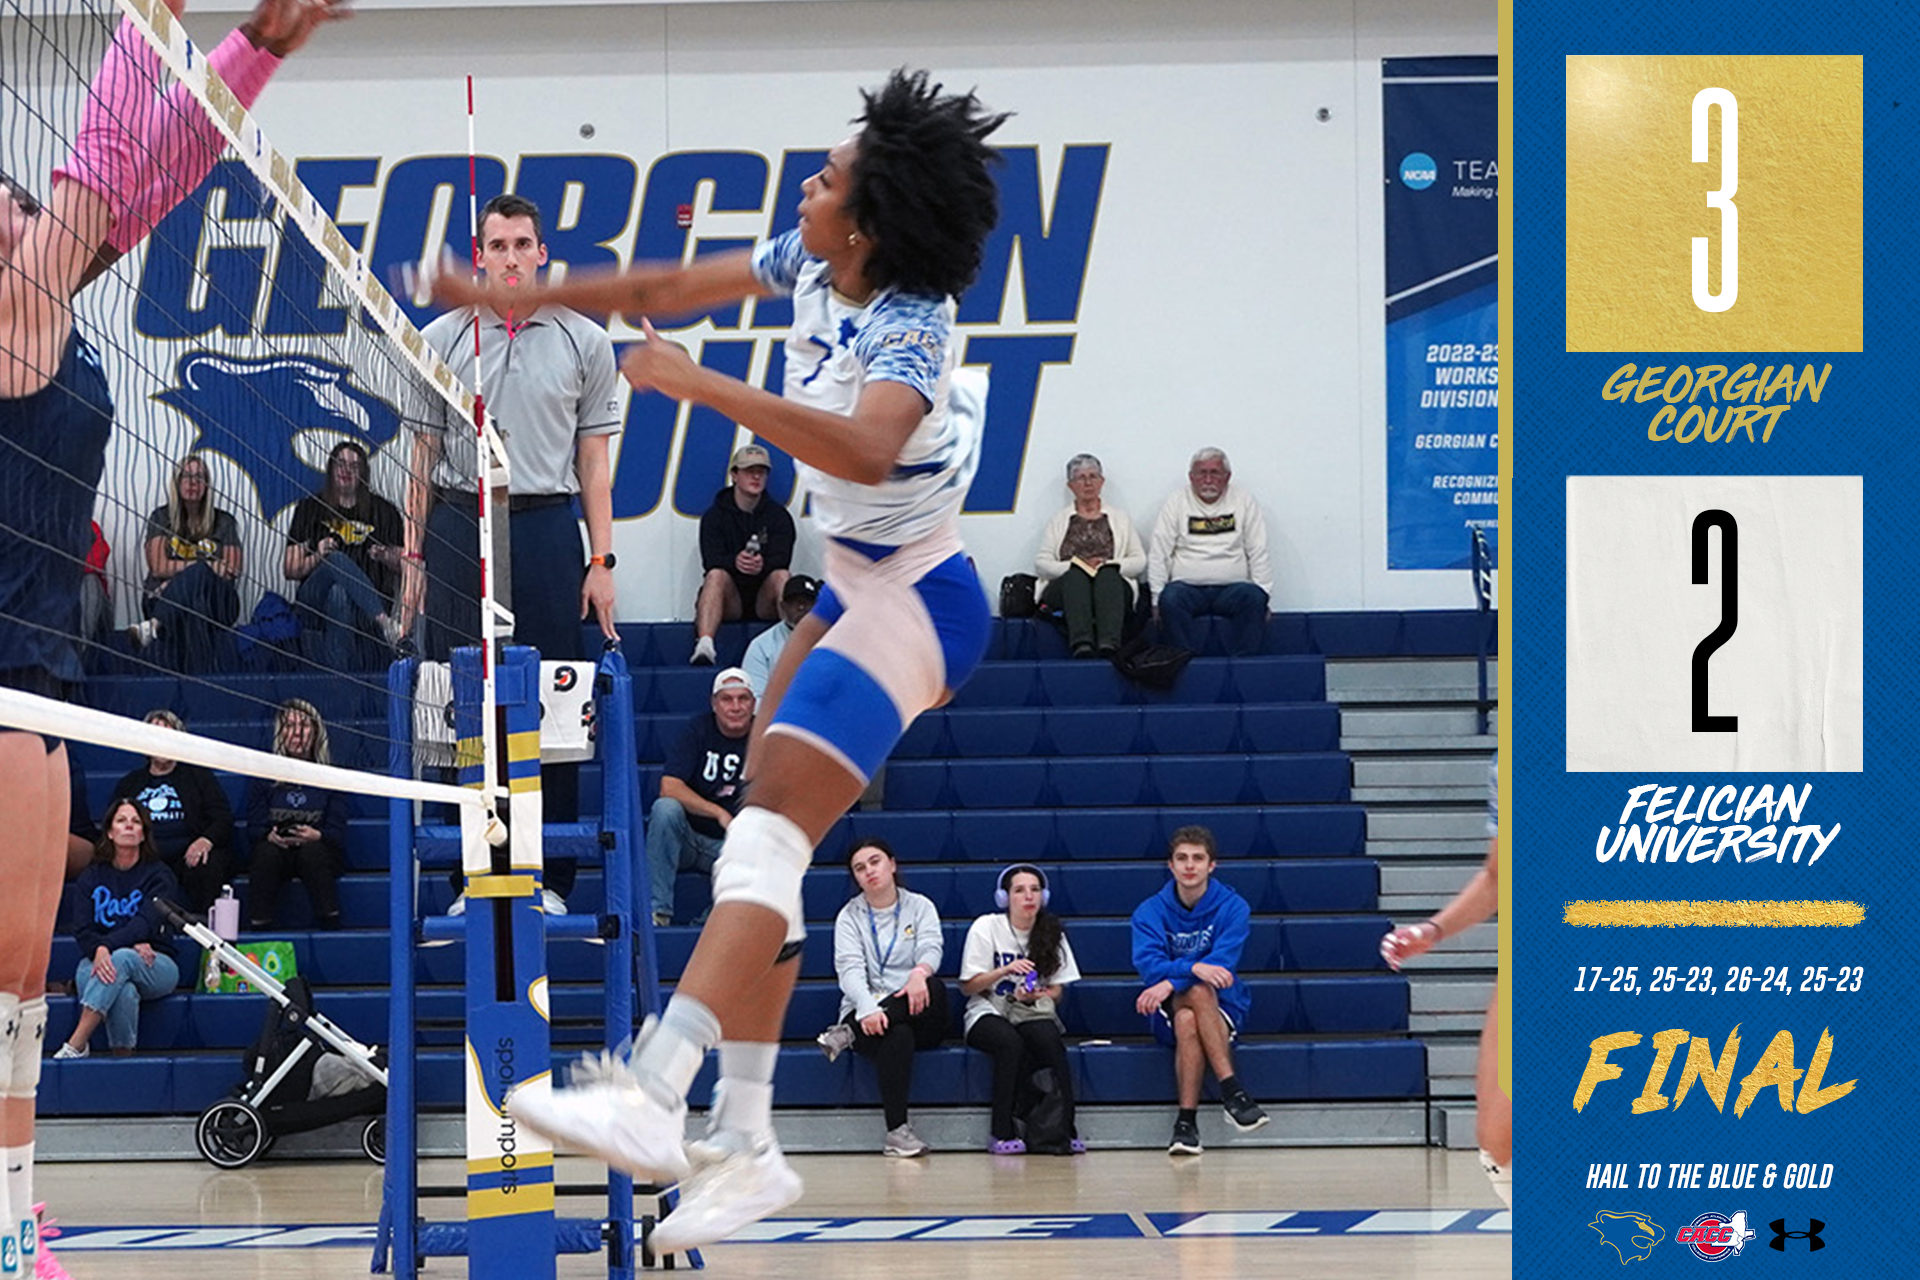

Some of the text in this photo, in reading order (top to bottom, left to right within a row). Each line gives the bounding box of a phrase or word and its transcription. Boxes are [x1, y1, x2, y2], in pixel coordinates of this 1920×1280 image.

[1402, 170, 1436, 181] NCAA
[1452, 186, 1493, 199] Making
[1415, 434, 1486, 449] GEORGIAN
[703, 750, 744, 781] US
